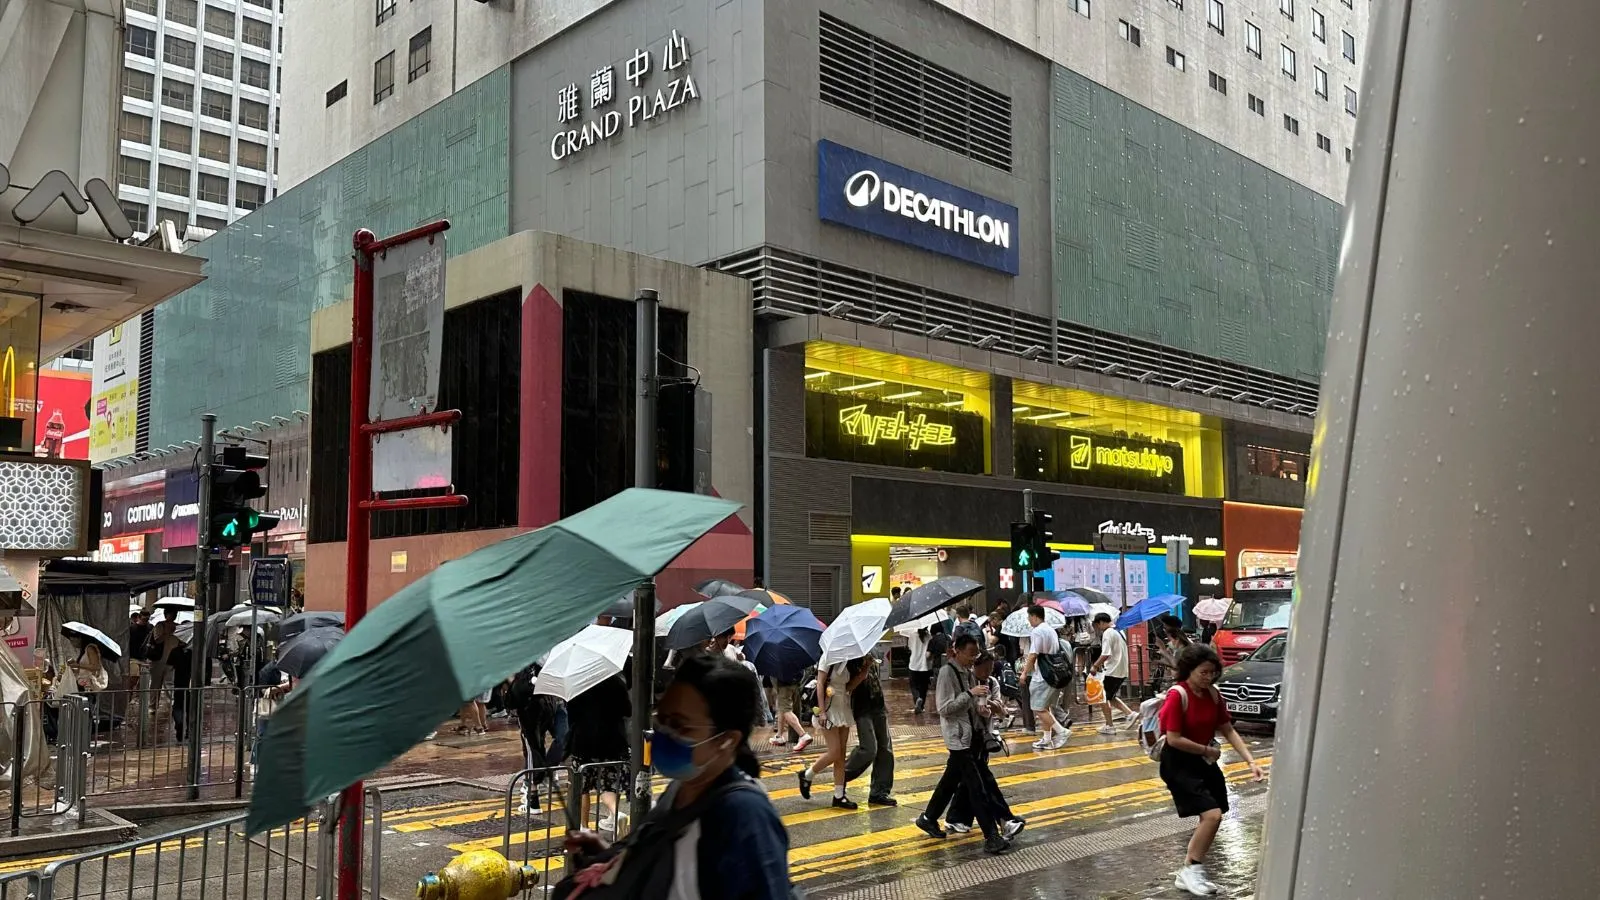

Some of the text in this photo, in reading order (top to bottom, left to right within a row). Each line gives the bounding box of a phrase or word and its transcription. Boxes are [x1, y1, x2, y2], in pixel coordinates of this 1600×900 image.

[557, 29, 690, 124] 雅蘭中心
[551, 74, 699, 161] GRAND PLAZA
[883, 181, 1009, 249] DECATHLON
[1096, 446, 1174, 477] matsukiyo
[128, 503, 157, 523] COTTON
[280, 507, 299, 520] PLAZA
[1238, 704, 1259, 712] 2268
